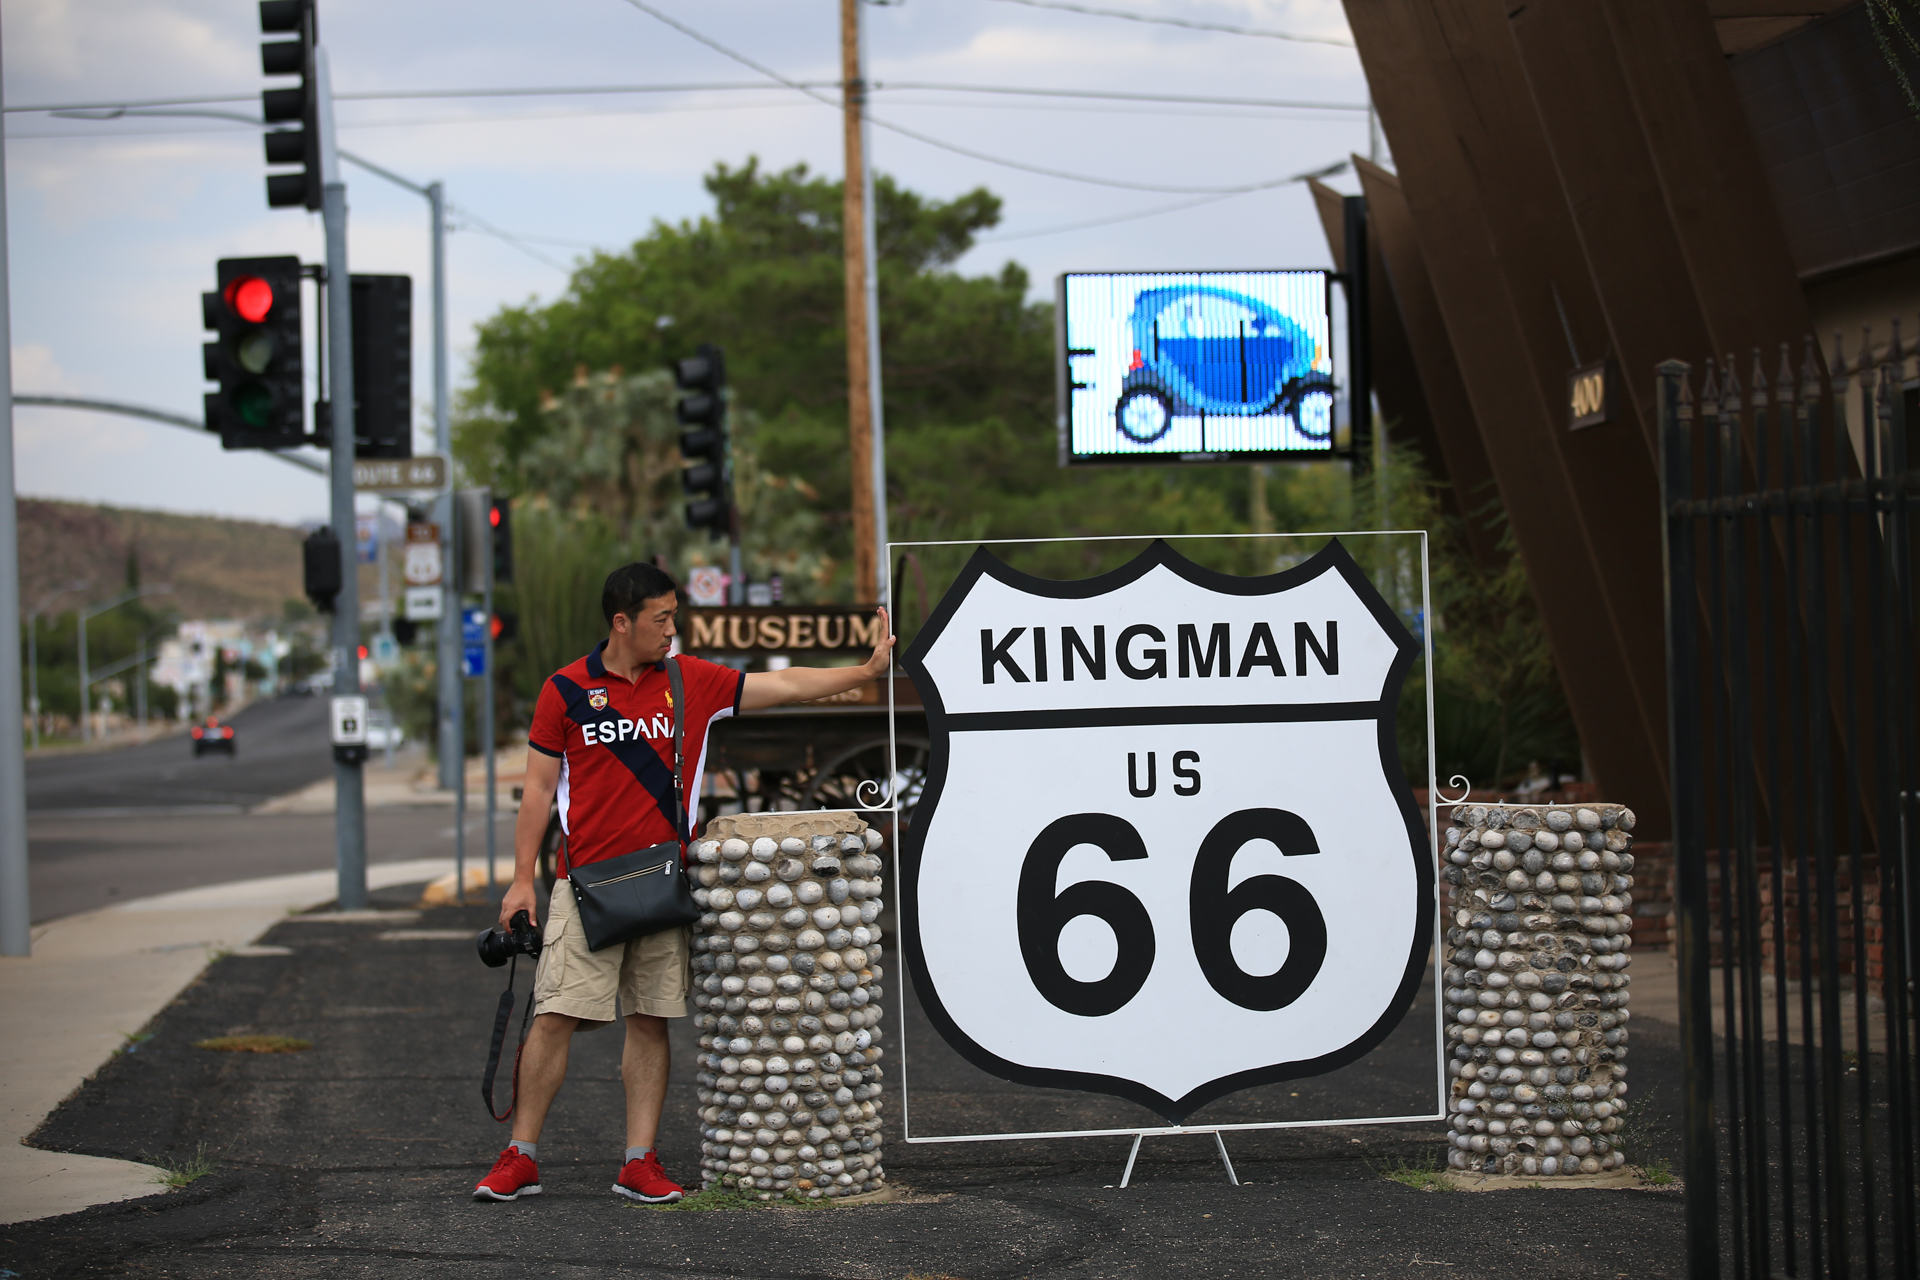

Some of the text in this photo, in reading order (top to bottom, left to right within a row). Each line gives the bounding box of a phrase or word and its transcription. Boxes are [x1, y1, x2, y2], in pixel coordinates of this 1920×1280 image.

[1571, 373, 1604, 418] 400
[353, 462, 435, 486] OUTE 66
[691, 615, 881, 648] MUSEUM
[981, 621, 1338, 684] KINGMAN
[1128, 751, 1200, 798] US
[1017, 808, 1327, 1017] 66
